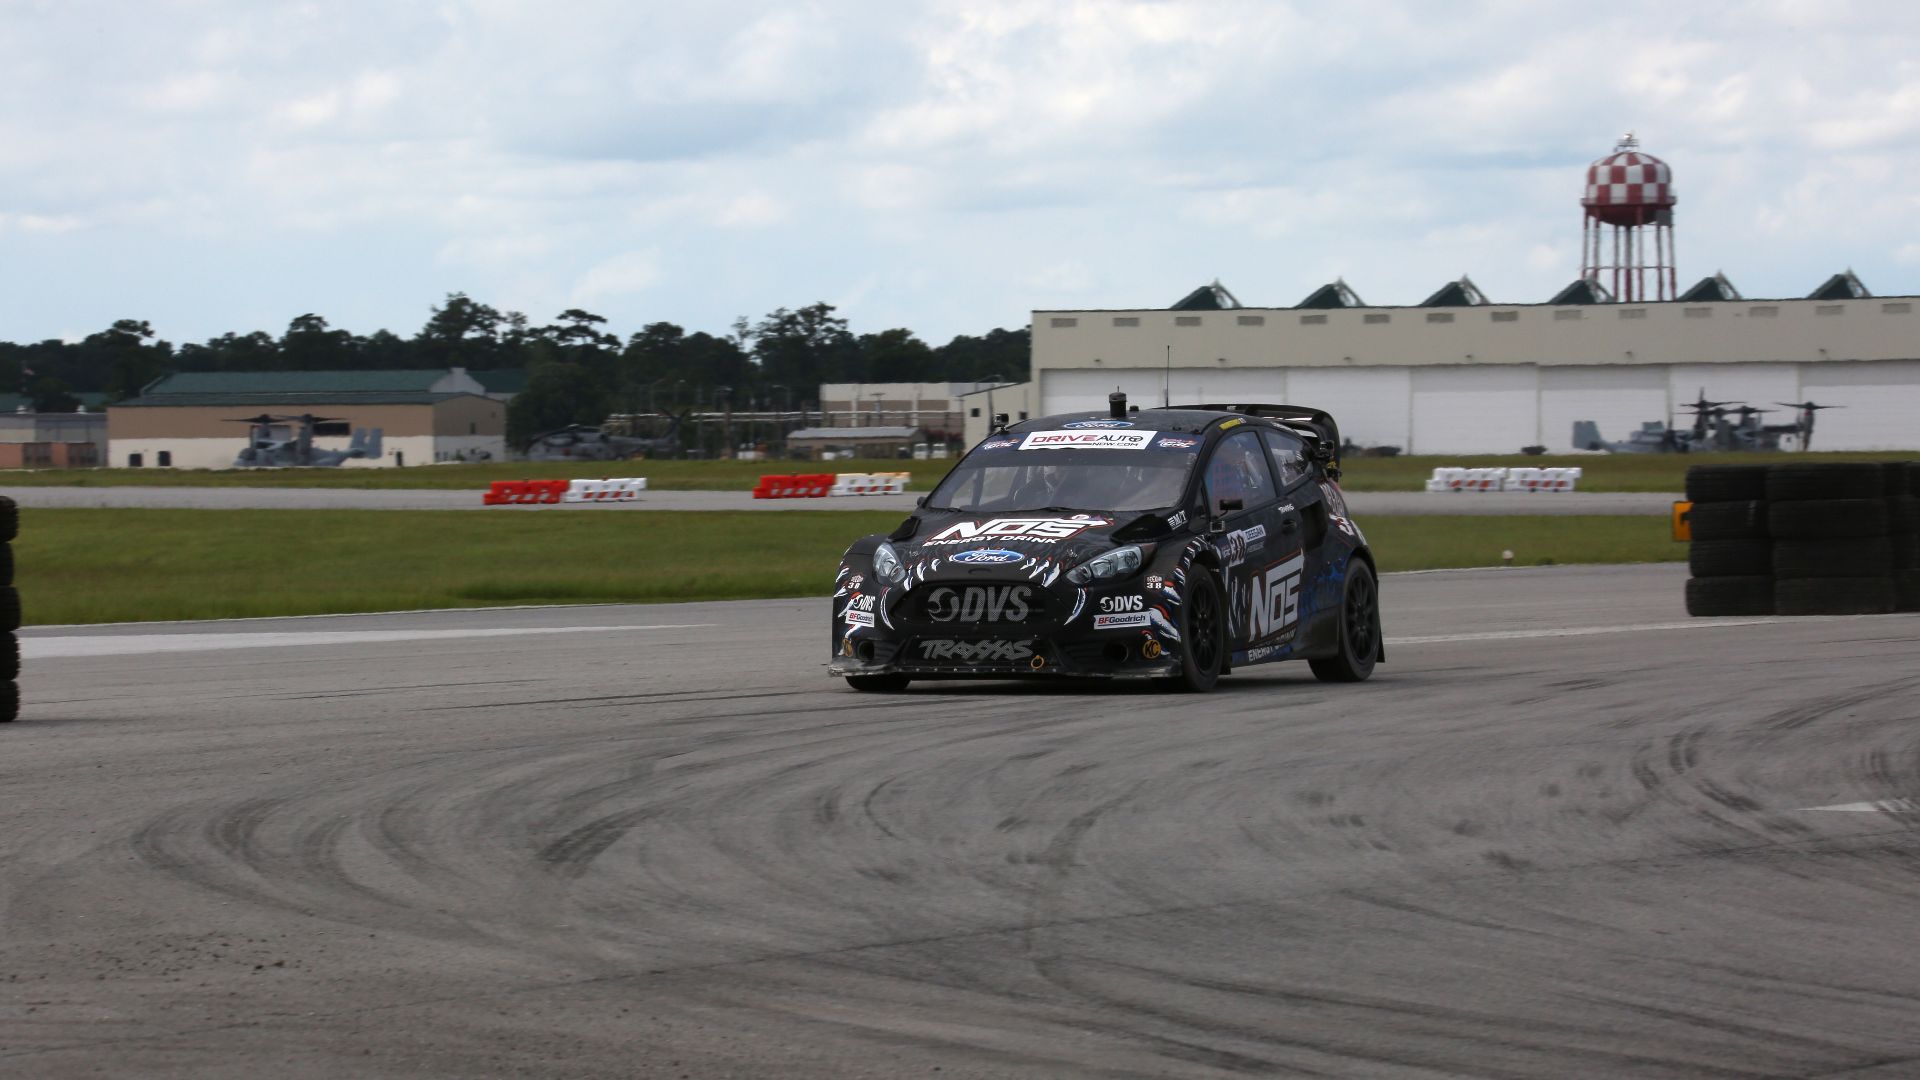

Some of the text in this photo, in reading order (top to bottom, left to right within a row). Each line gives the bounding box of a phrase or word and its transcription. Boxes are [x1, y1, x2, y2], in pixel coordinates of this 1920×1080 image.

[931, 518, 1108, 540] NOS
[922, 536, 1061, 547] ENERGY DRINK
[965, 551, 1007, 562] Ford
[860, 594, 876, 612] DVS
[960, 586, 1032, 622] DVS
[1114, 595, 1143, 612] DVS
[1249, 554, 1304, 642] NOS
[1098, 614, 1146, 625] BFGoodrich
[919, 639, 1034, 661] TRAXXAS
[1144, 640, 1159, 657] KC
